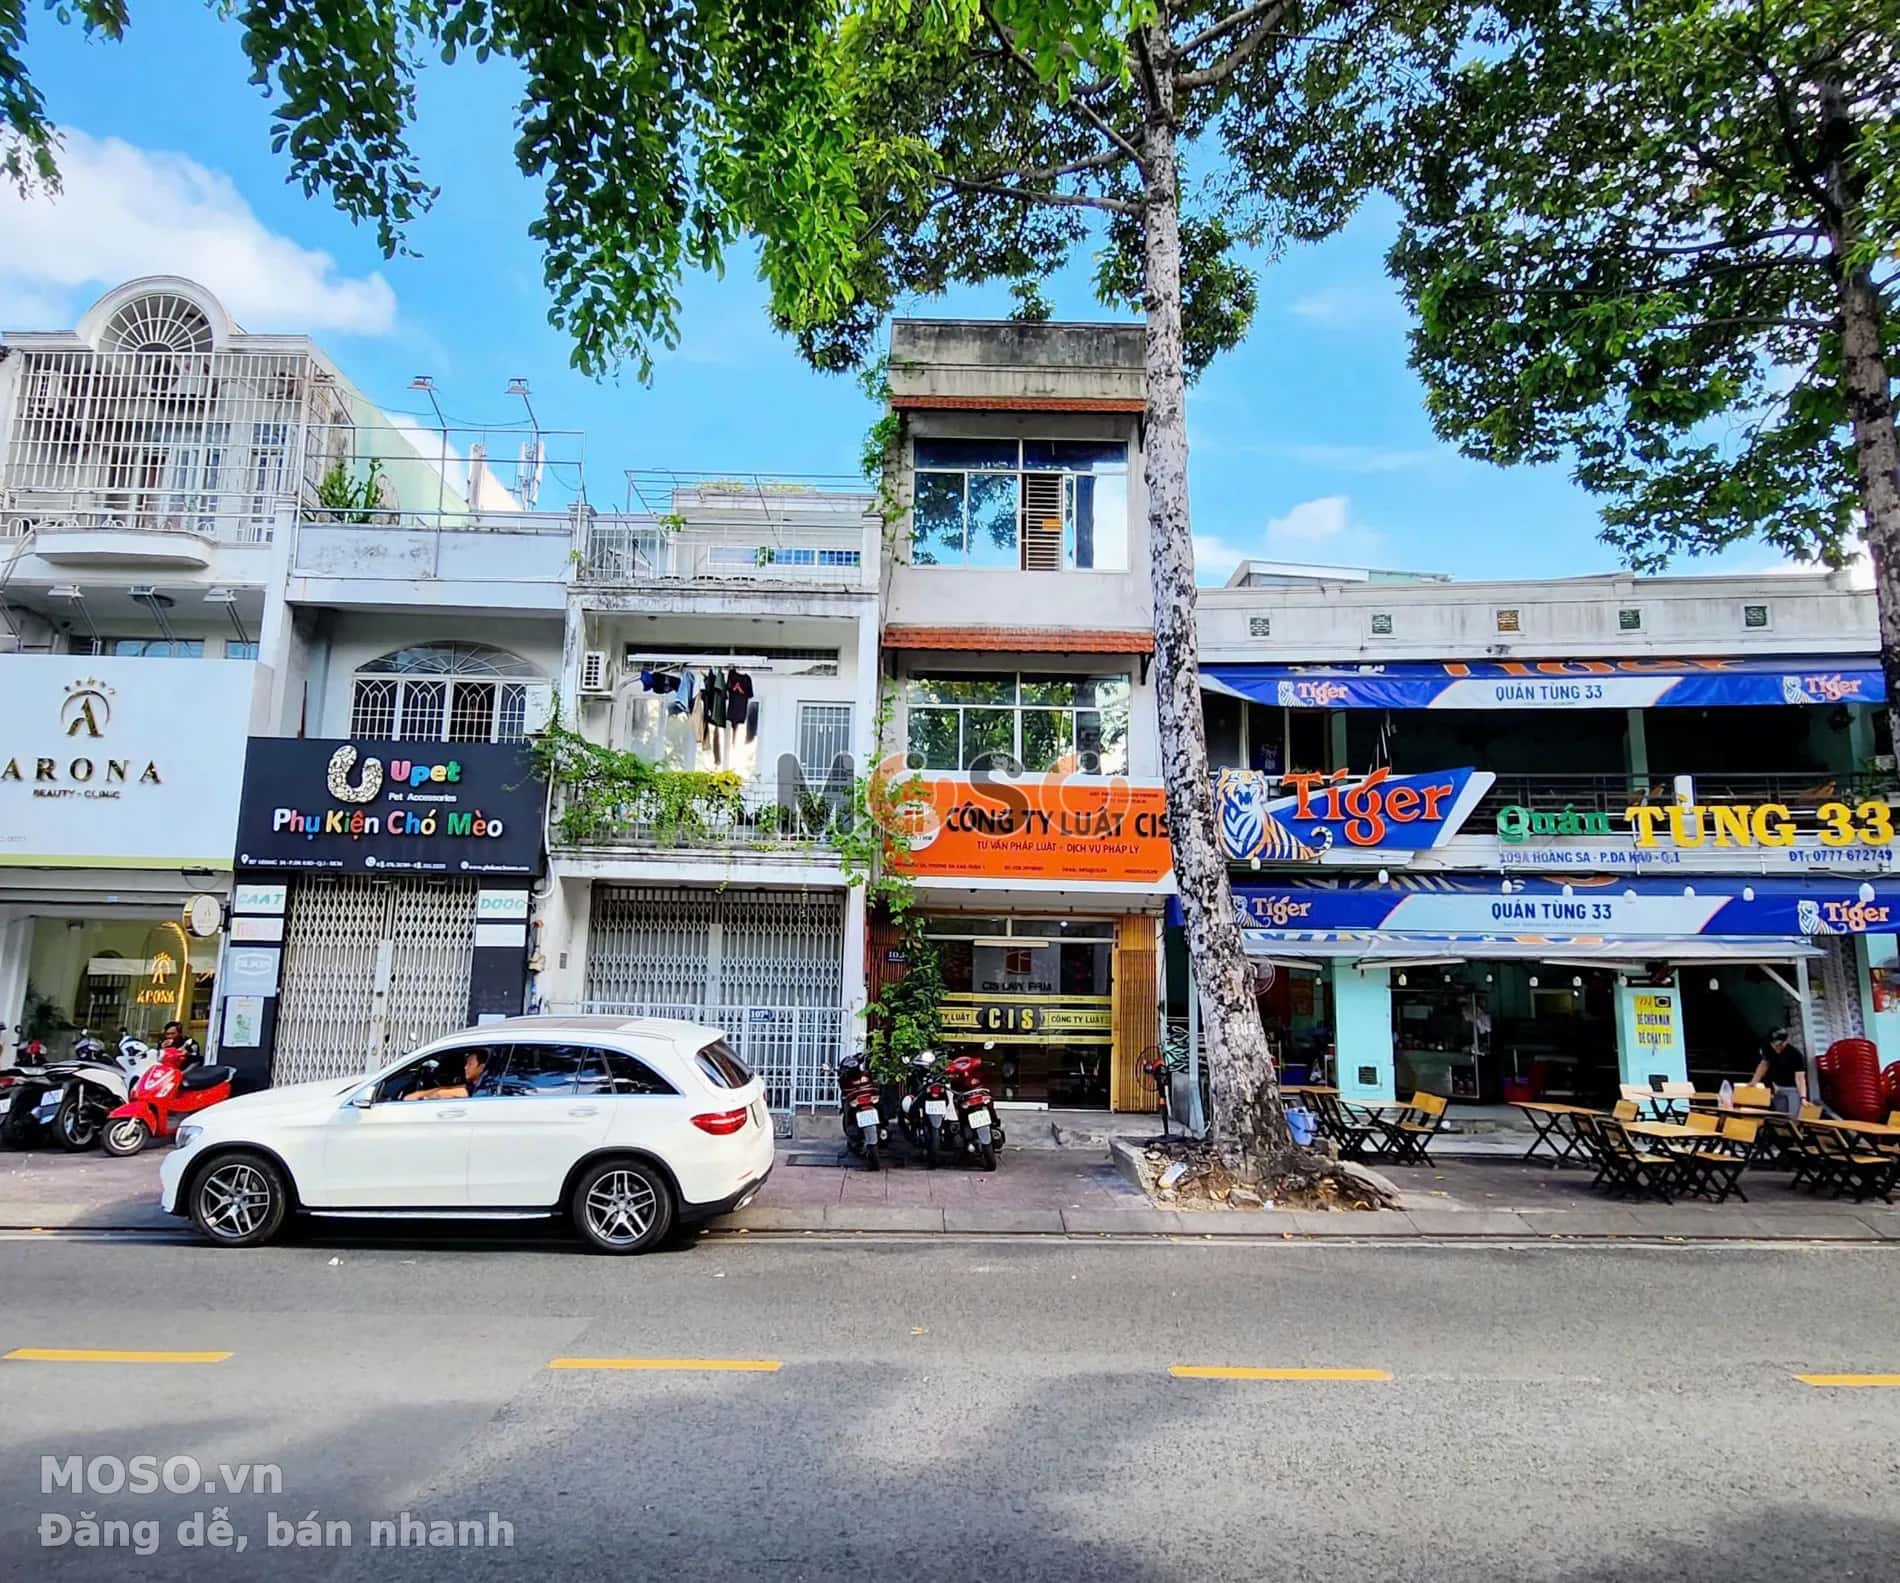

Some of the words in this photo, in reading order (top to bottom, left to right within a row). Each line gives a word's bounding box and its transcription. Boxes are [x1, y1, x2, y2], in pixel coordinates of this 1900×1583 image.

[1298, 680, 1350, 704] Tiger
[1496, 682, 1534, 701] QUÁN
[1585, 685, 1602, 699] 33
[1805, 673, 1863, 701] Tiger
[0, 757, 162, 784] ARONA
[390, 760, 462, 787] Upet
[33, 788, 75, 798] BEAUTY
[84, 790, 120, 799] CLINIC
[388, 792, 404, 801] Pet
[1282, 766, 1454, 846] Tiger
[272, 808, 320, 840] Phụ
[326, 809, 380, 840] Kiện
[387, 808, 437, 836] Chó
[447, 809, 503, 838] Mèo
[946, 801, 1014, 833] CÔNG
[1022, 807, 1054, 835] TY
[1061, 806, 1124, 840] LUẬT
[1135, 812, 1170, 838] CIS
[1496, 804, 1611, 843] Quán
[1817, 802, 1895, 847] 33
[1576, 852, 1590, 863] SA
[1251, 895, 1312, 925] Tiger
[1492, 899, 1536, 920] QUÁN
[1541, 899, 1586, 919] TÙNG
[1592, 903, 1612, 919] 33
[1822, 899, 1890, 932] Tiger
[988, 1007, 1034, 1029] CIS
